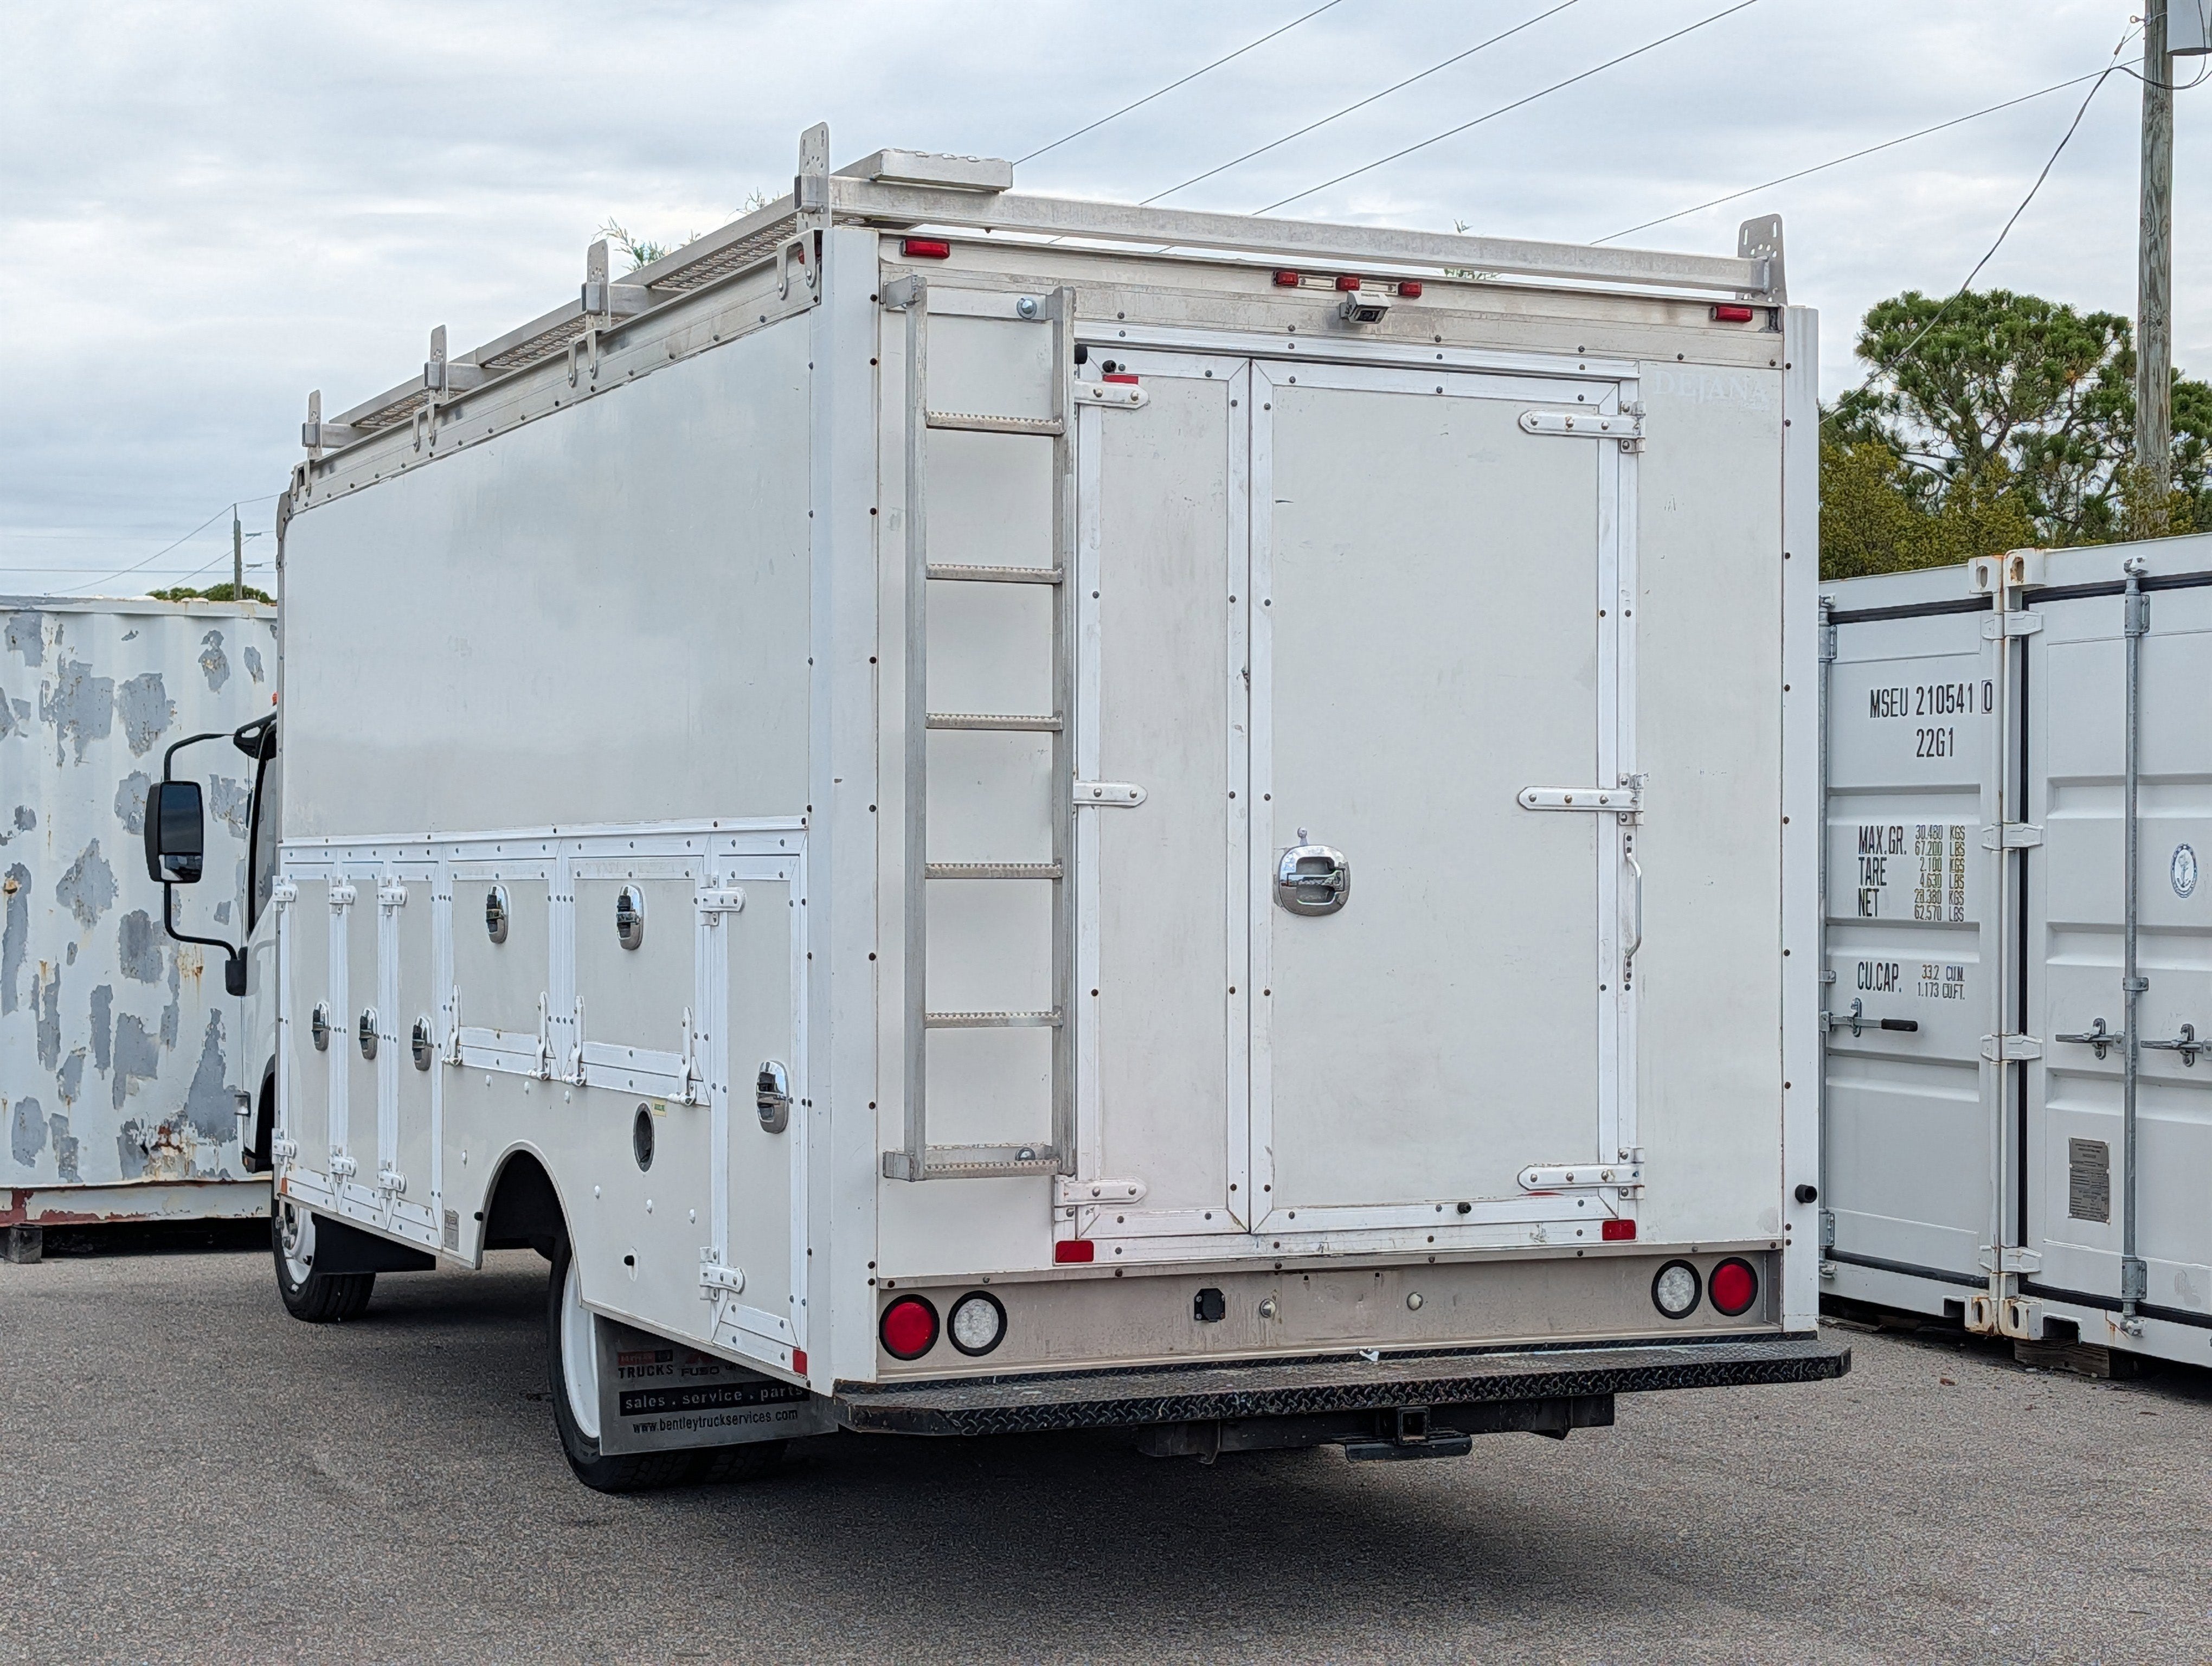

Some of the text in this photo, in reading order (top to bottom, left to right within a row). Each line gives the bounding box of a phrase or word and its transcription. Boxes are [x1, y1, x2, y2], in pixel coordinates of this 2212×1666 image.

[1870, 688, 1908, 718] MSEU
[1915, 682, 1973, 717] 210541
[1916, 727, 1953, 758] 22G1
[1859, 825, 1907, 855] MAX.GR.
[1950, 824, 1965, 841] KGS
[1949, 841, 1965, 857] LBS
[1859, 856, 1965, 887] TARE 2.100 KGS
[1920, 873, 1965, 889] 4.630 LBS
[1858, 888, 1879, 917] NET
[1949, 890, 1964, 905] KGS
[1949, 906, 1964, 922] LBS
[1857, 962, 1901, 992] CU.CAP.
[1918, 982, 1939, 998] 1.173
[618, 1364, 673, 1379] TRUCKS
[625, 1385, 803, 1409] sales service parts
[633, 1409, 798, 1434] www.bentleytruckservices.com
